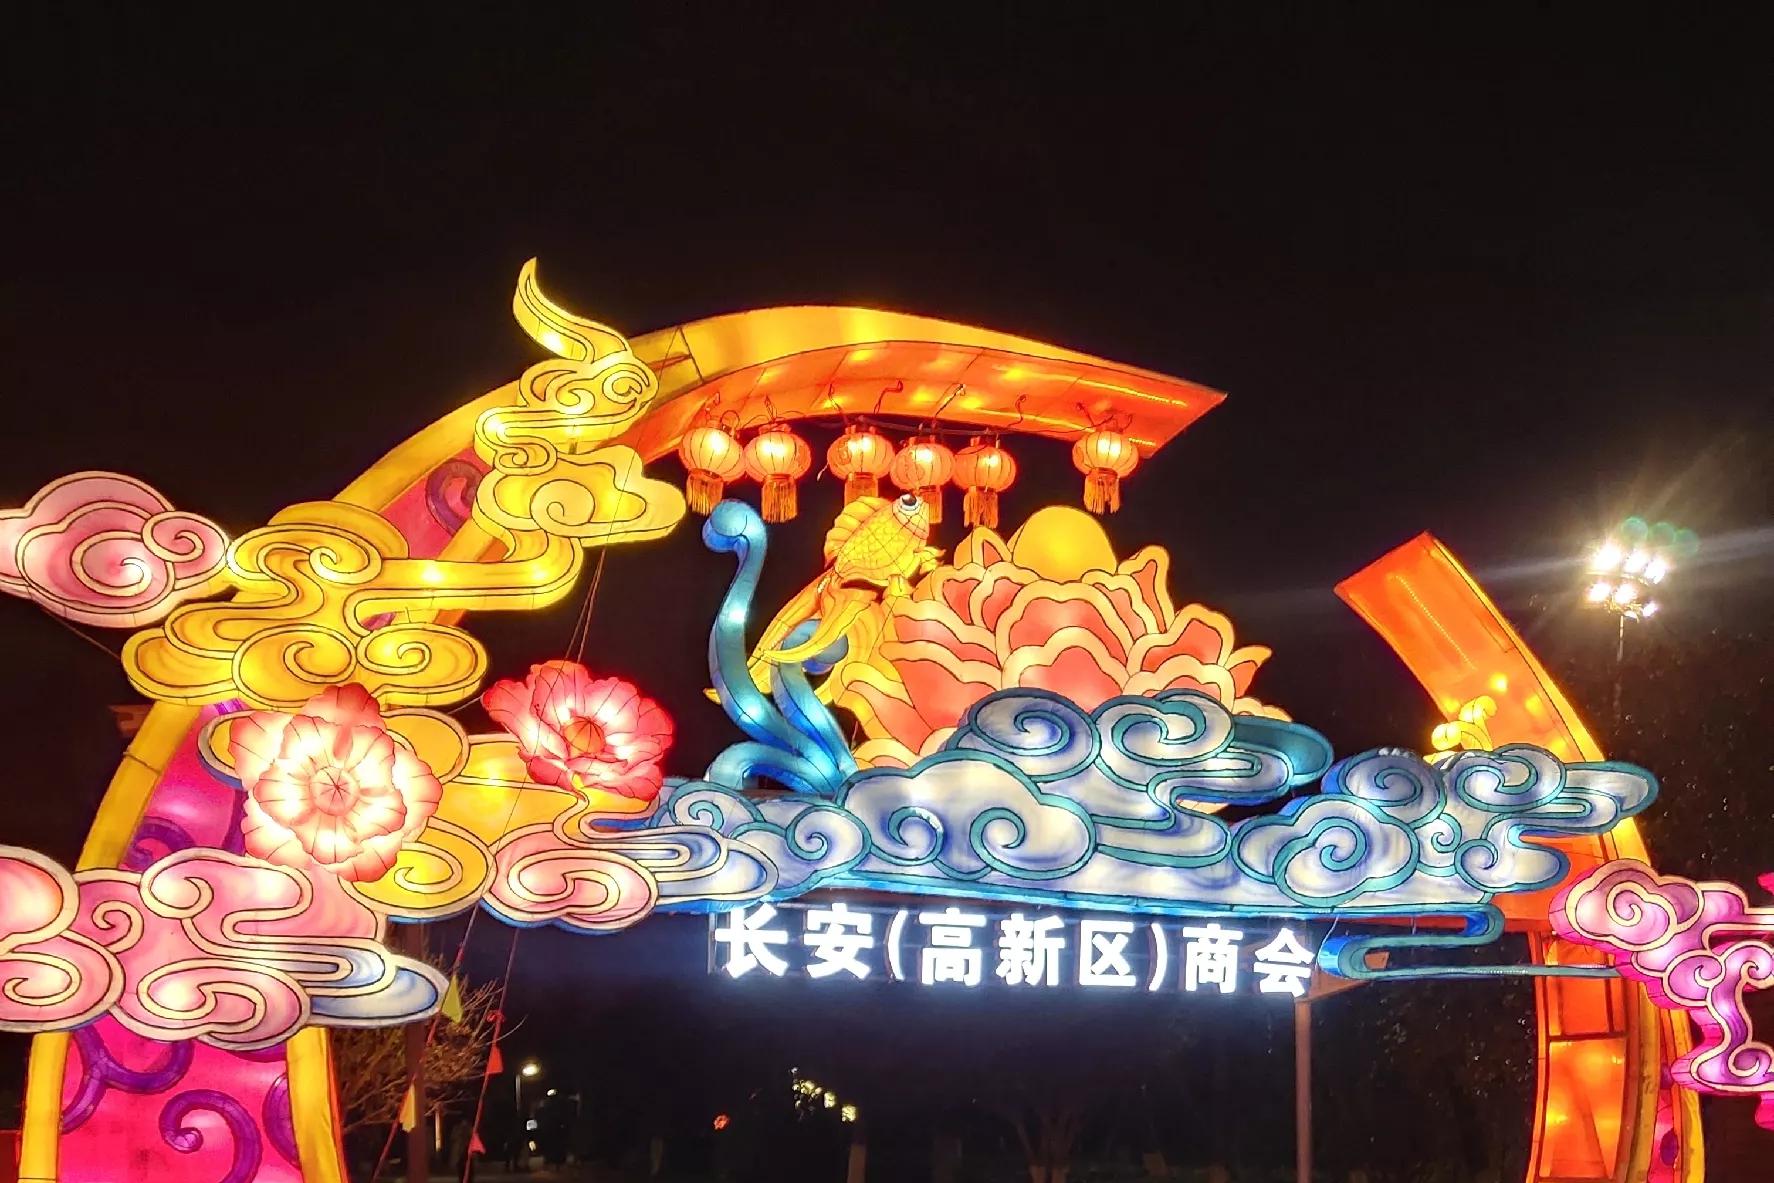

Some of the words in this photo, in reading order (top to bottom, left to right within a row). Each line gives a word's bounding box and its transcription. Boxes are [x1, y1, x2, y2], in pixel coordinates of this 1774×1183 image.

[714, 902, 1315, 997] 长安(高新区)商会
